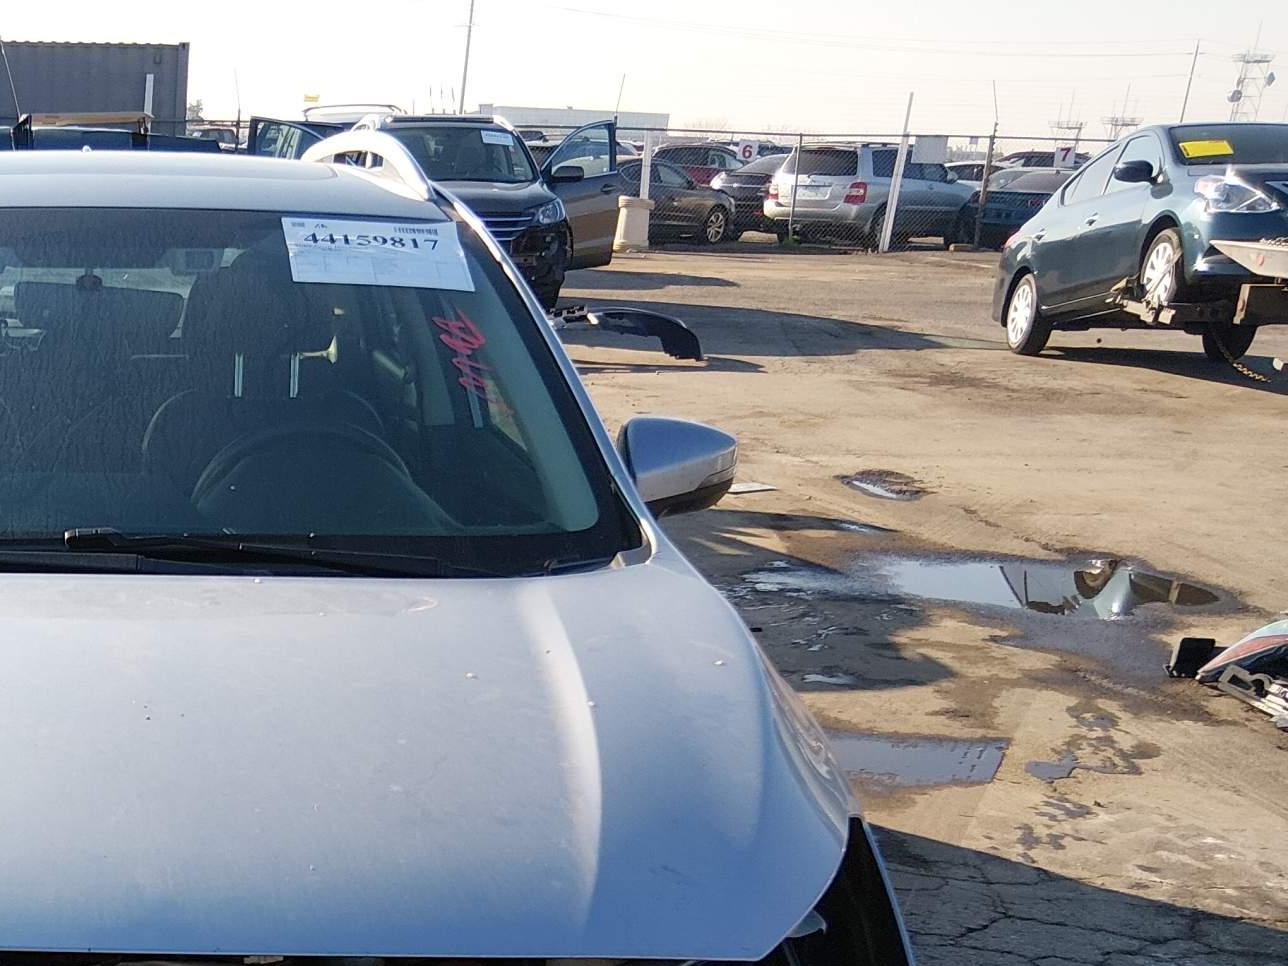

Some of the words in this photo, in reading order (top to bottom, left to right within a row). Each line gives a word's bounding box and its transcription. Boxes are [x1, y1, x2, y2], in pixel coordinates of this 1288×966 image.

[742, 144, 753, 159] 6
[1060, 147, 1072, 162] 7
[303, 231, 440, 251] 44159817
